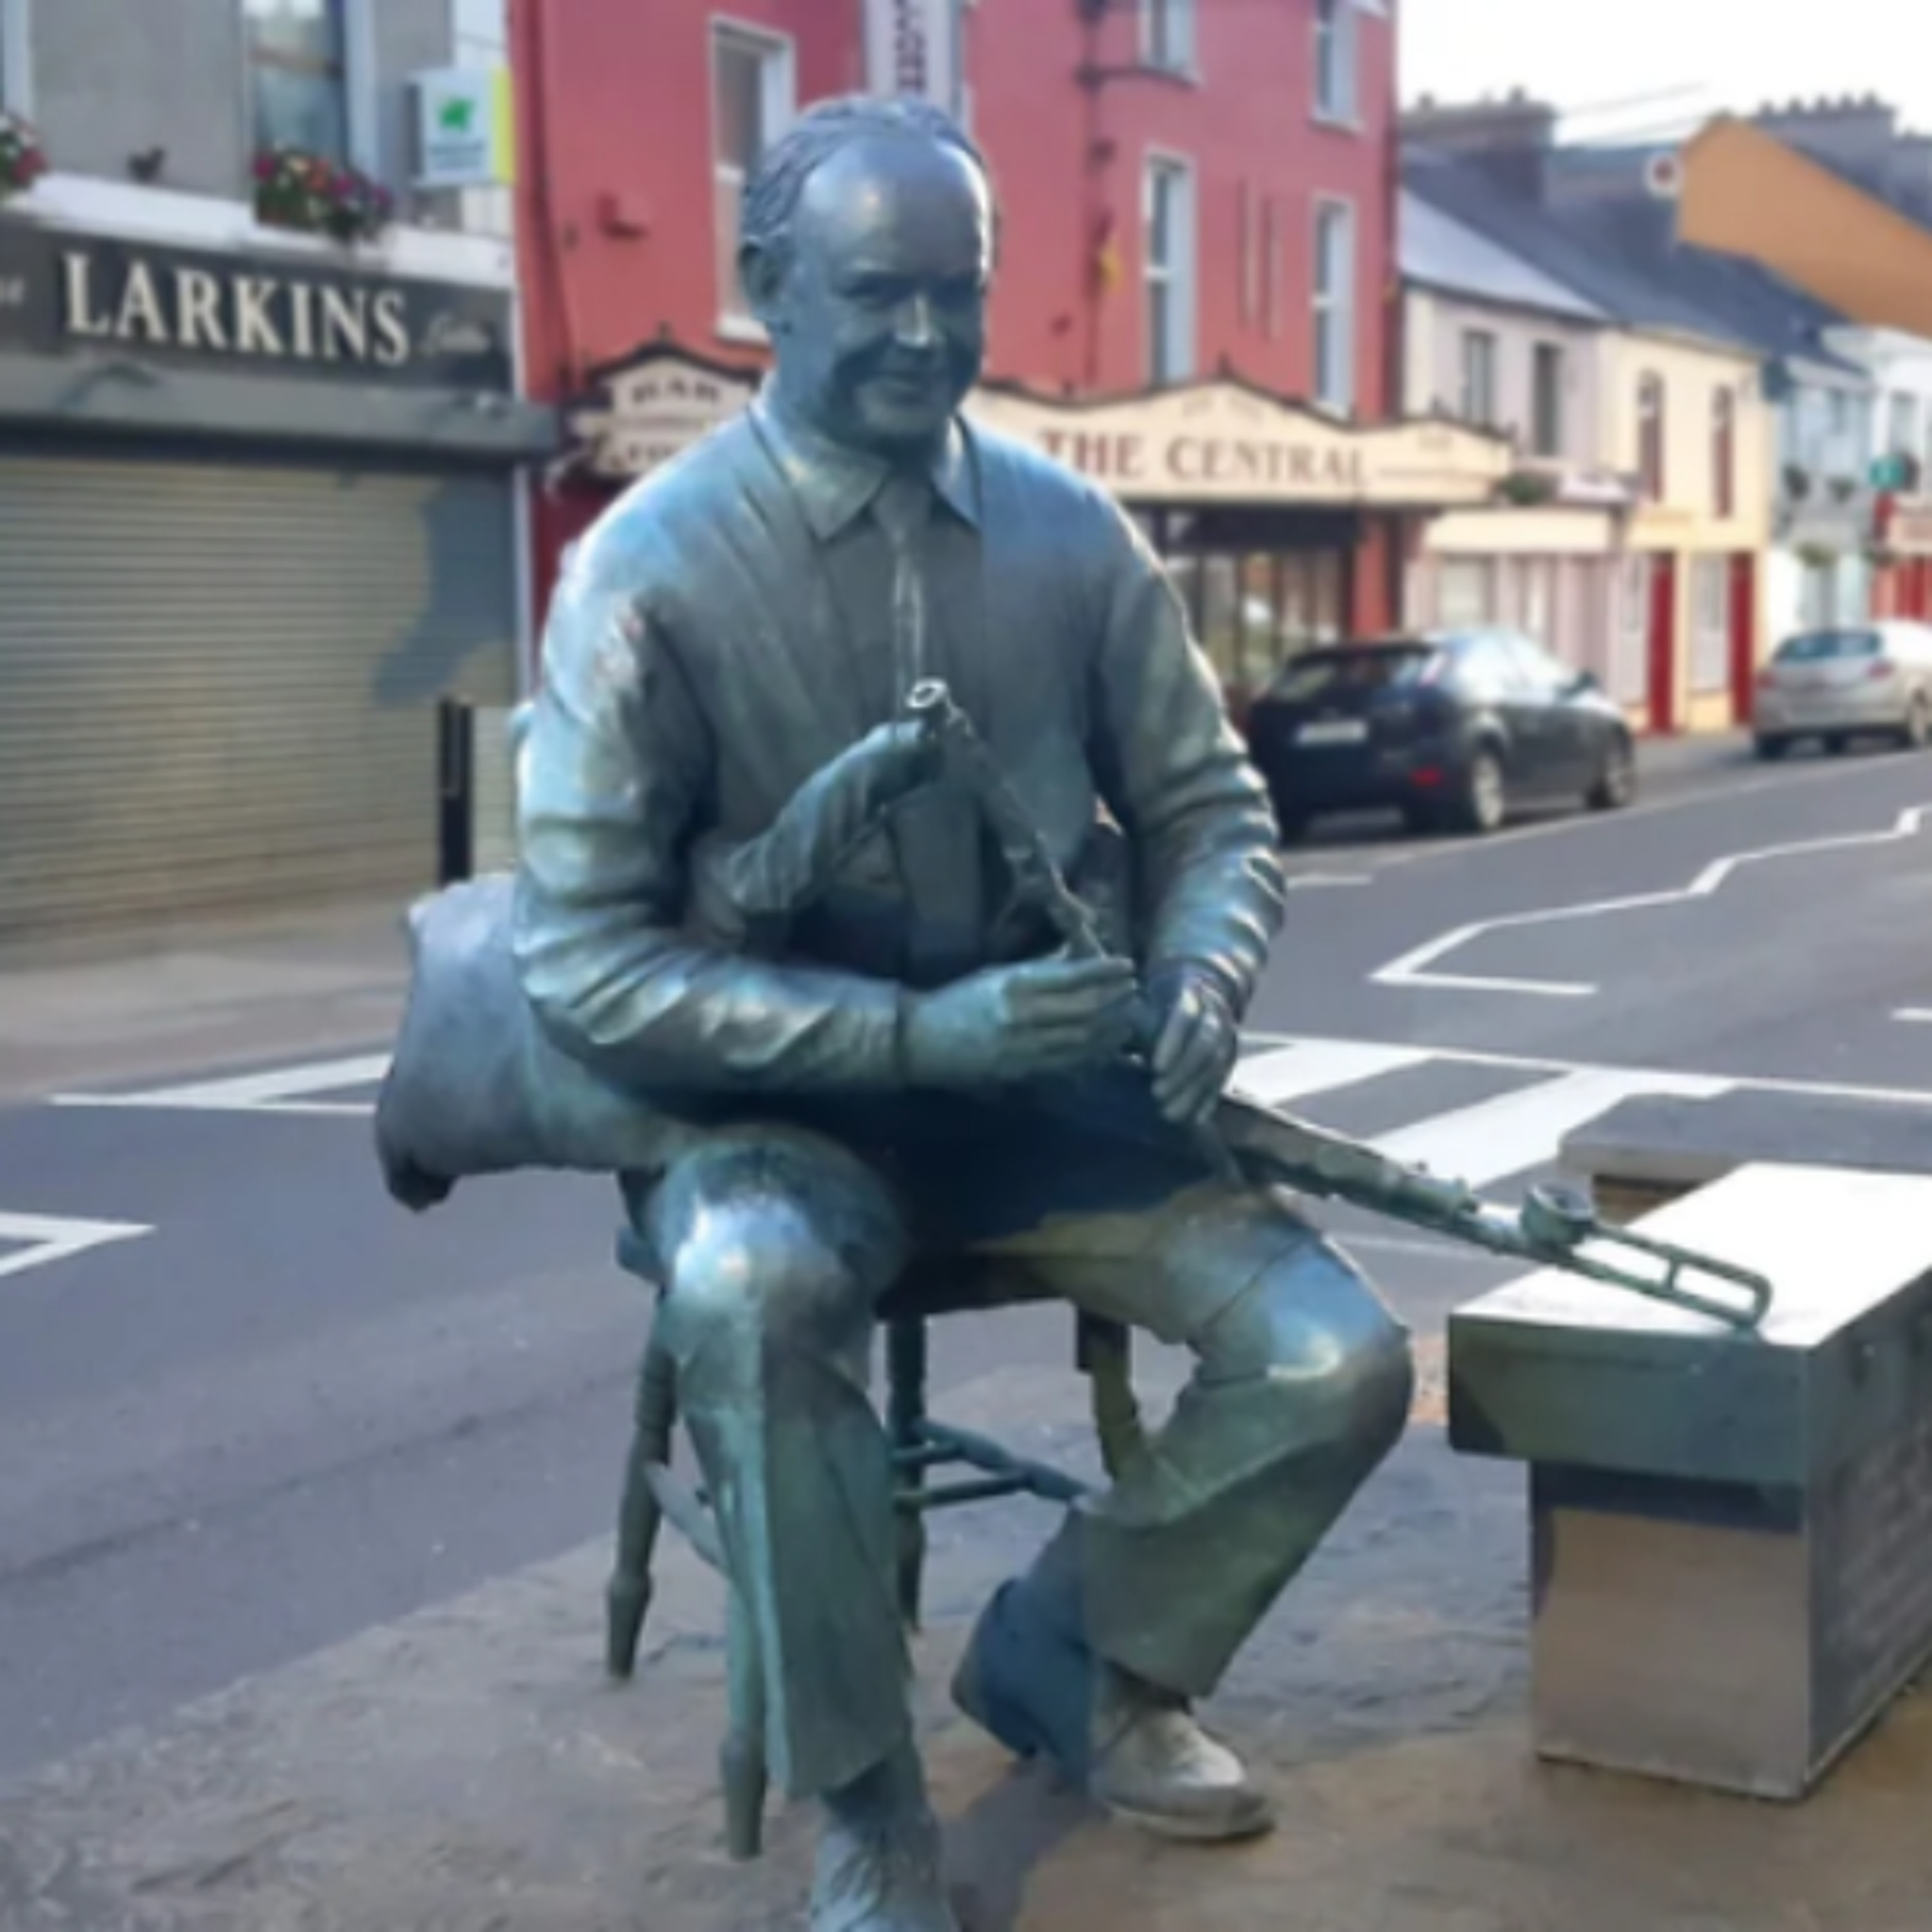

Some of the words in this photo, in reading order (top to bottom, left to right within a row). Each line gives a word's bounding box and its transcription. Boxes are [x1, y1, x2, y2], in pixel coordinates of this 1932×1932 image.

[64, 252, 410, 365] LARKINS
[1039, 430, 1142, 478] THE
[1166, 435, 1365, 486] CENTRAL
